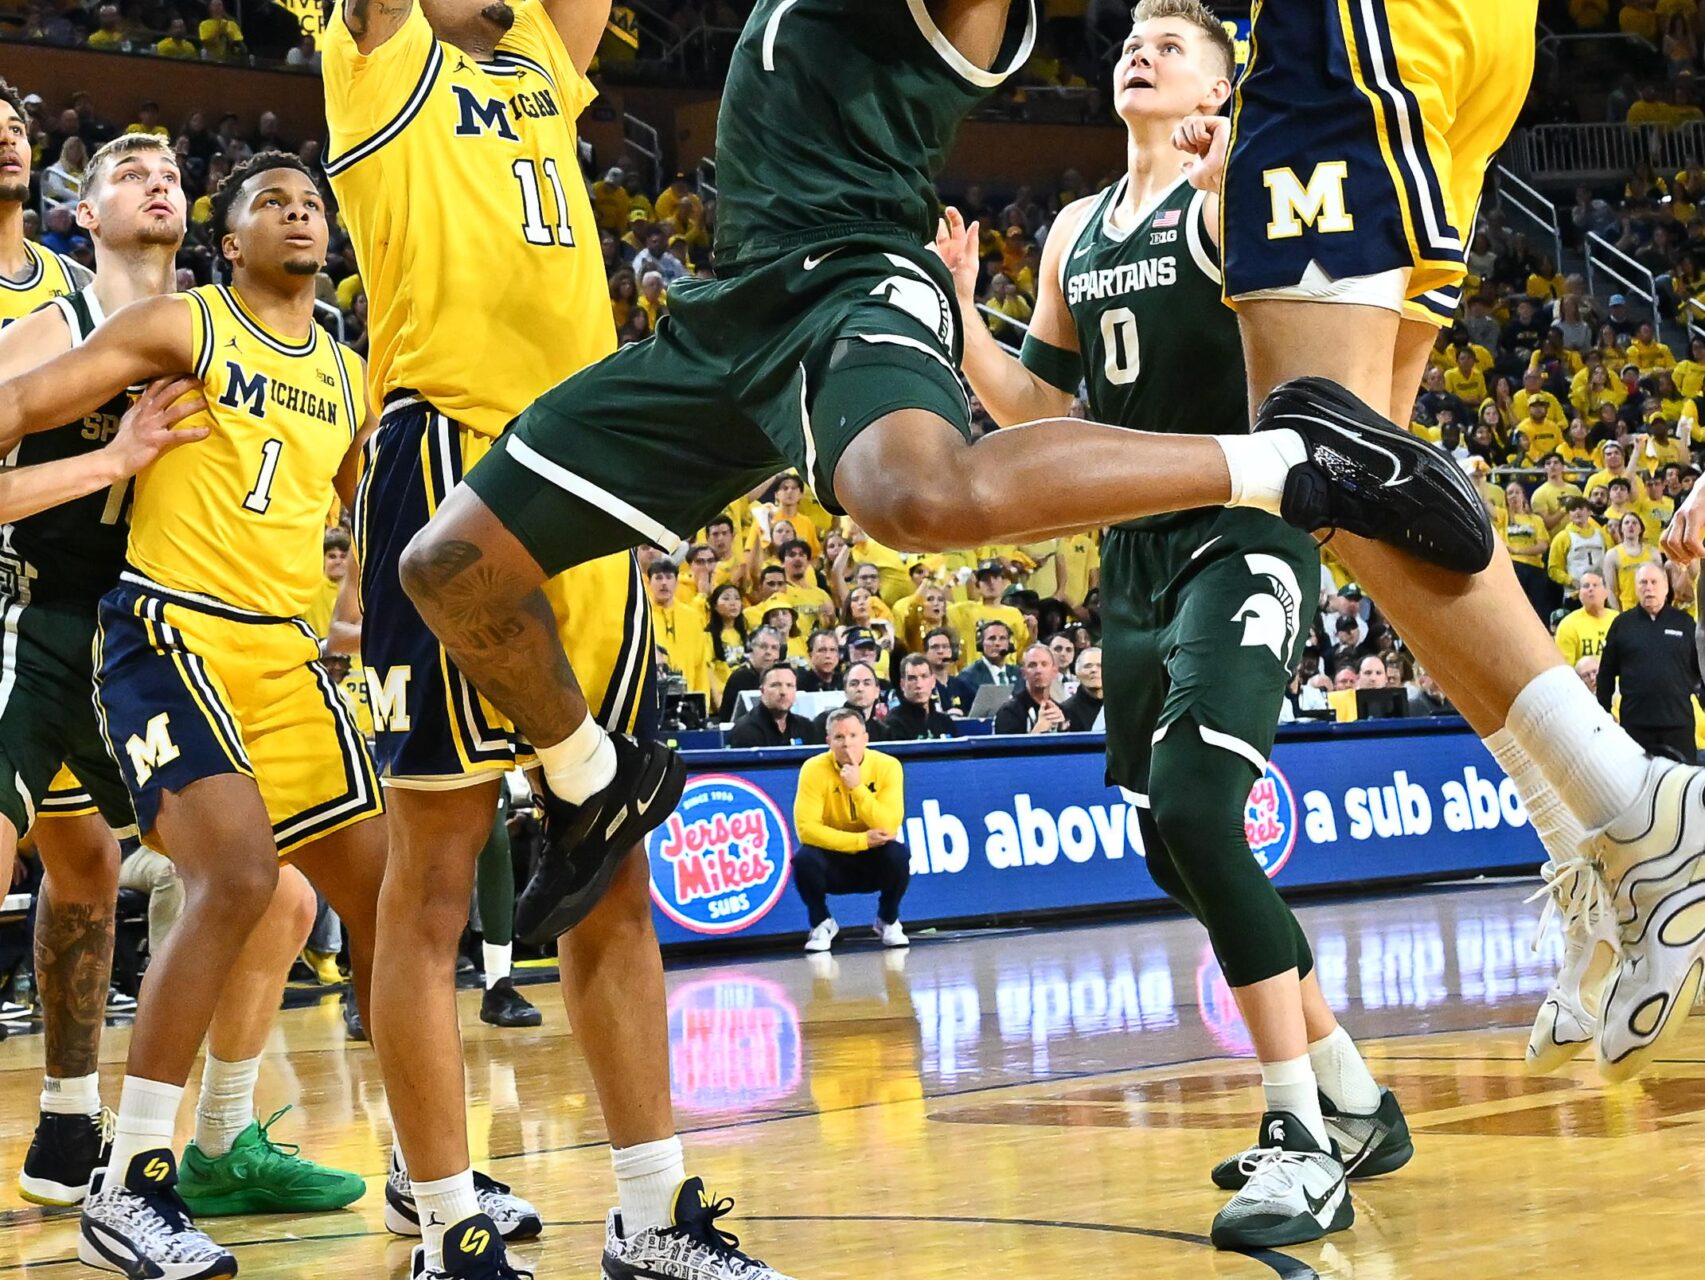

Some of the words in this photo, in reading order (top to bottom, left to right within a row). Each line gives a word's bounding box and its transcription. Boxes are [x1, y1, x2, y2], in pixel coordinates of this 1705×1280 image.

[511, 157, 576, 248] 11
[1262, 160, 1355, 240] M
[1067, 255, 1178, 306] SPARTANS
[1100, 306, 1141, 386] 0
[218, 360, 338, 426] MICHIGAN
[241, 437, 284, 516] 1
[363, 664, 412, 732] M
[124, 711, 181, 789] M
[663, 810, 767, 858] Jersey
[900, 799, 970, 876] ub
[1302, 789, 1338, 844] a
[1344, 769, 1433, 840] sub
[707, 893, 750, 920] SUBS
